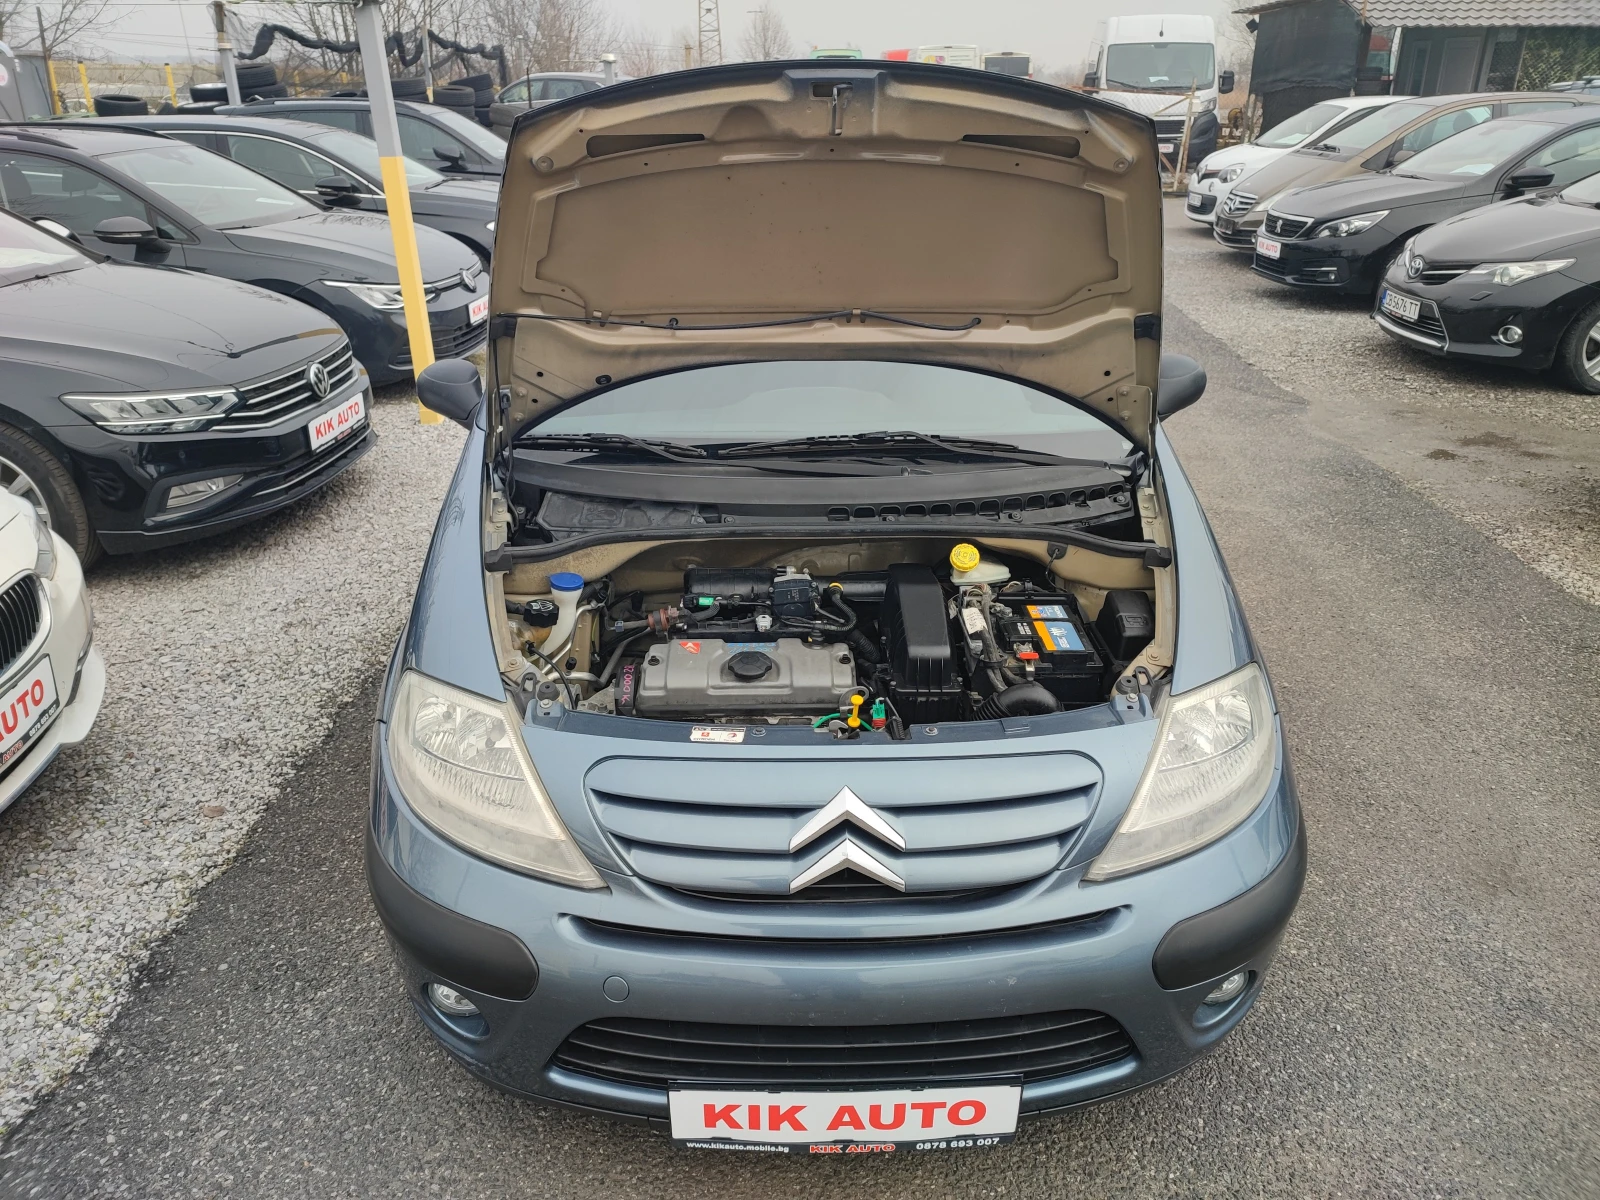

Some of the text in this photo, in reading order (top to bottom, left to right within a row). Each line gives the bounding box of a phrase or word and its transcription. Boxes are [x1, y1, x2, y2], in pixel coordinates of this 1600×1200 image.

[1409, 301, 1419, 317] TT
[315, 416, 335, 440] KIK
[337, 401, 360, 428] AUTO
[703, 1099, 987, 1132] KIK AUTO
[686, 1137, 1000, 1154] www.kikauto.mobile.bg KIK AUTO 0878 693 007
